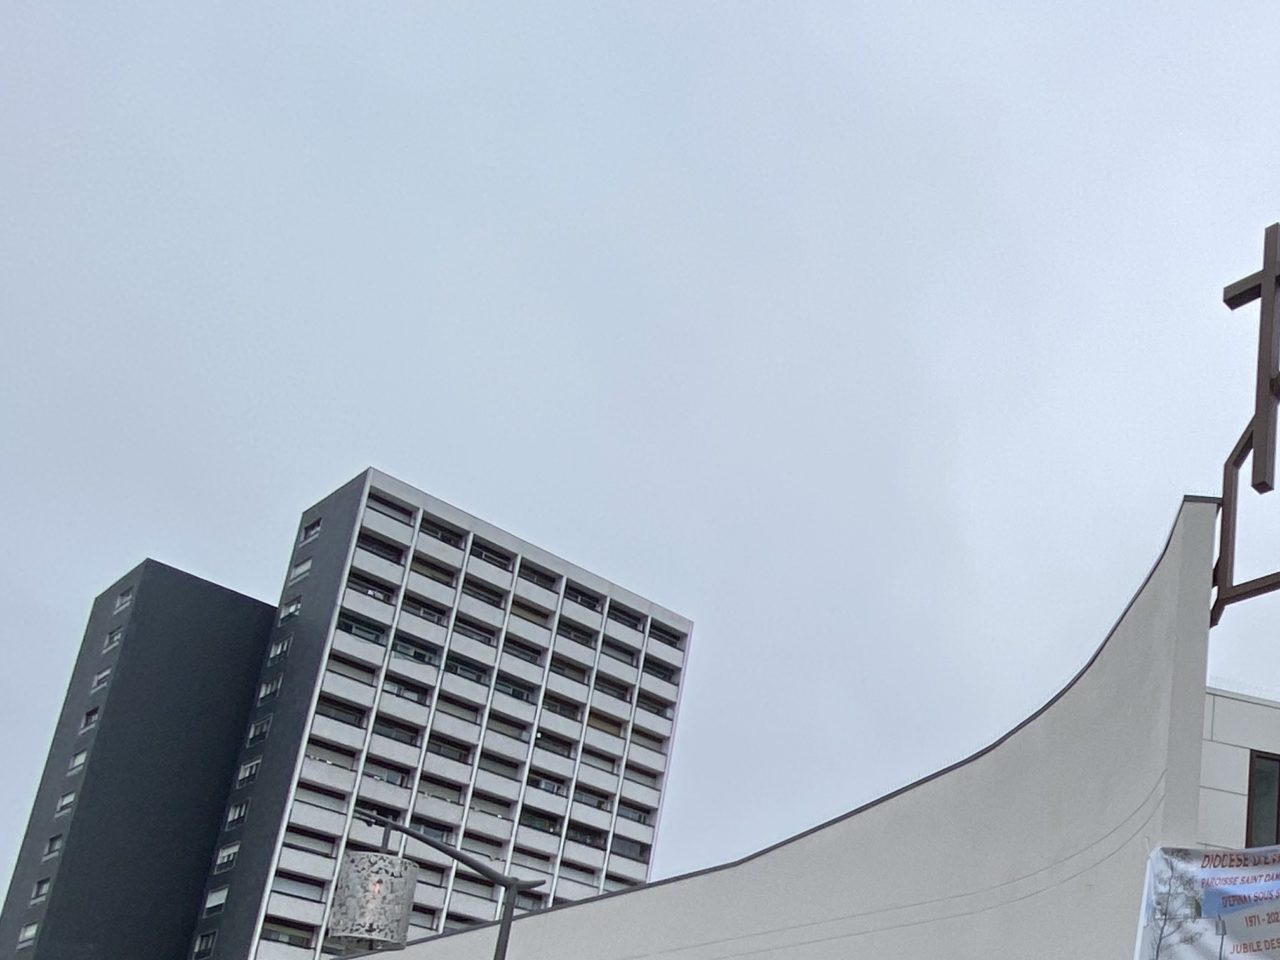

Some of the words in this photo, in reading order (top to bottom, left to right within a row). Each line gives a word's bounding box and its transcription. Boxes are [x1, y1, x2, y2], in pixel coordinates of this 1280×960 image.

[1201, 852, 1249, 869] DIOCESE
[1200, 876, 1239, 889] PAROISSE
[1239, 874, 1263, 885] SAINT
[1253, 888, 1275, 903] SOUS
[1229, 941, 1263, 955] JUBILE
